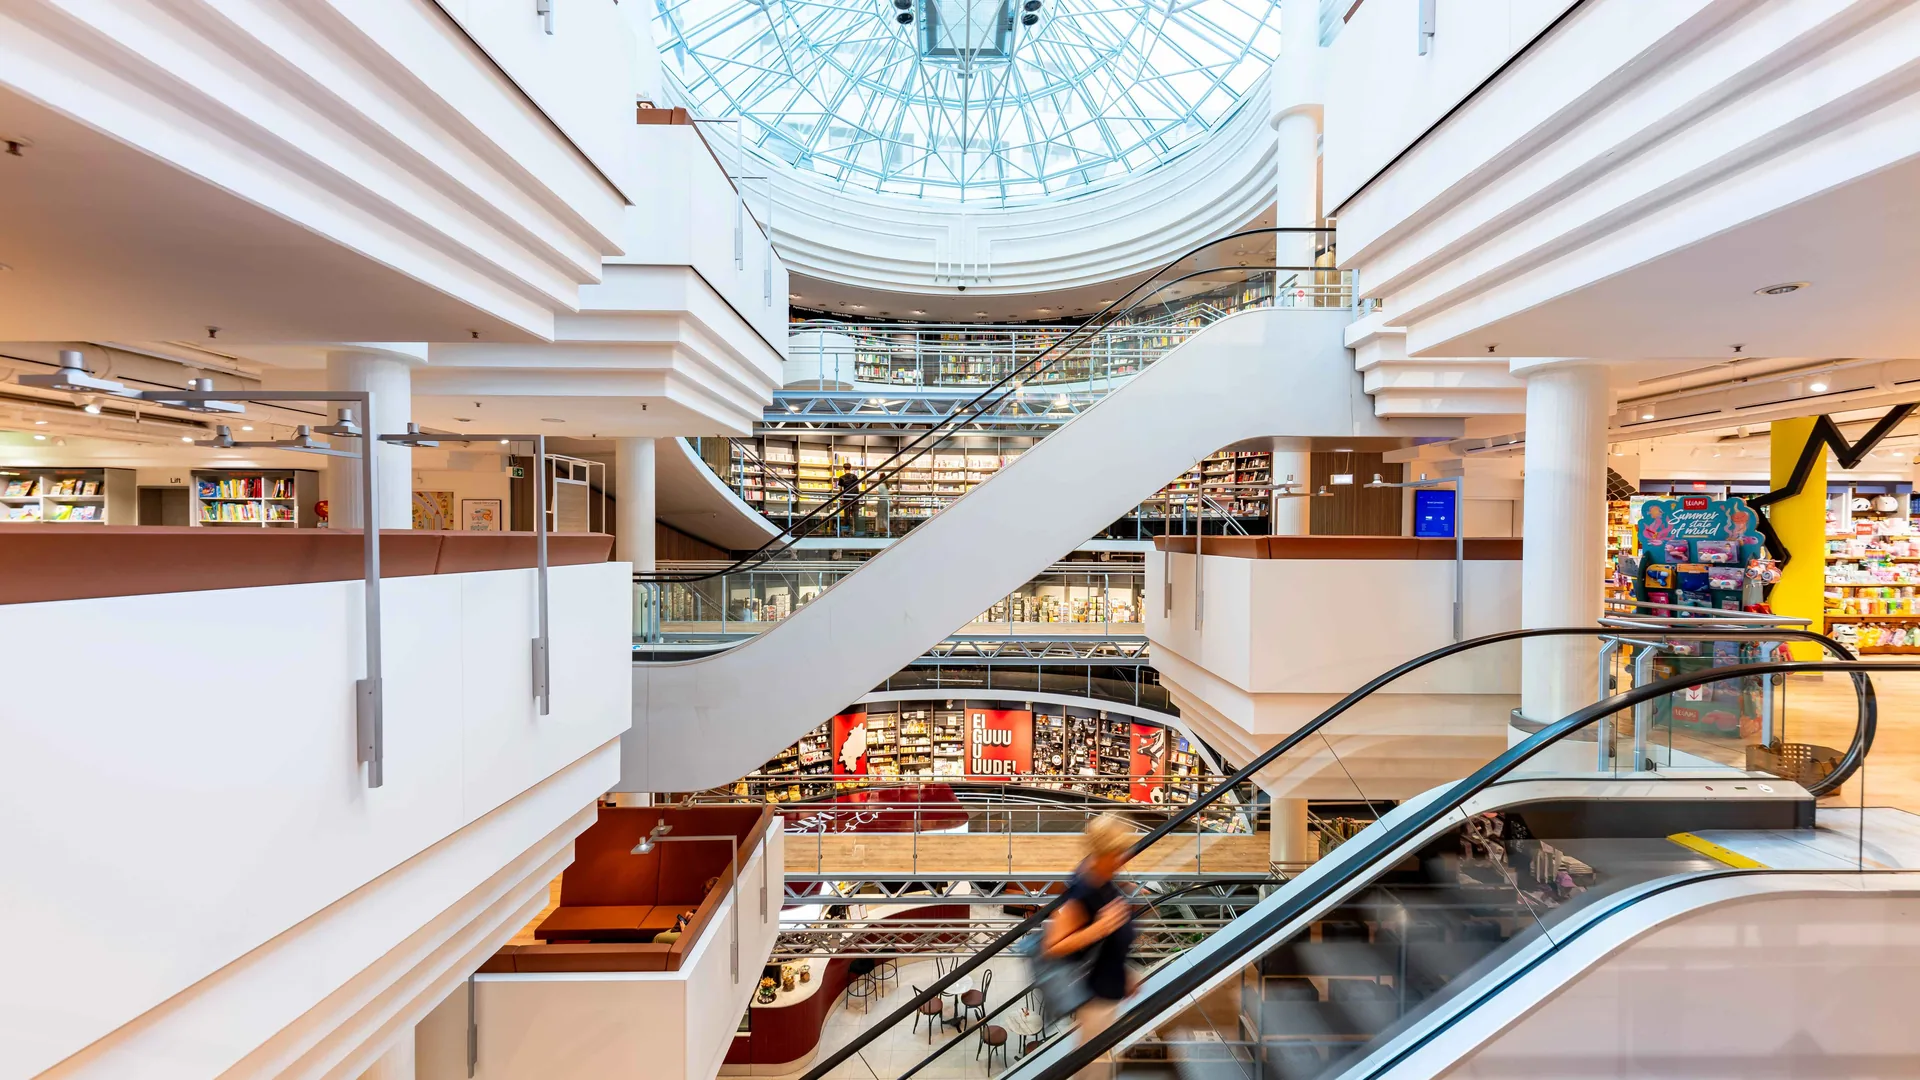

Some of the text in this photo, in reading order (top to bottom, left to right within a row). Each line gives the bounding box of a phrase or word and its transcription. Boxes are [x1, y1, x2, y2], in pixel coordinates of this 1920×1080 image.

[1668, 509, 1719, 525] Summer
[1671, 523, 1720, 538] of mind
[972, 729, 1012, 746] GUUU
[972, 743, 982, 759] U
[972, 758, 1017, 775] UUDE!
